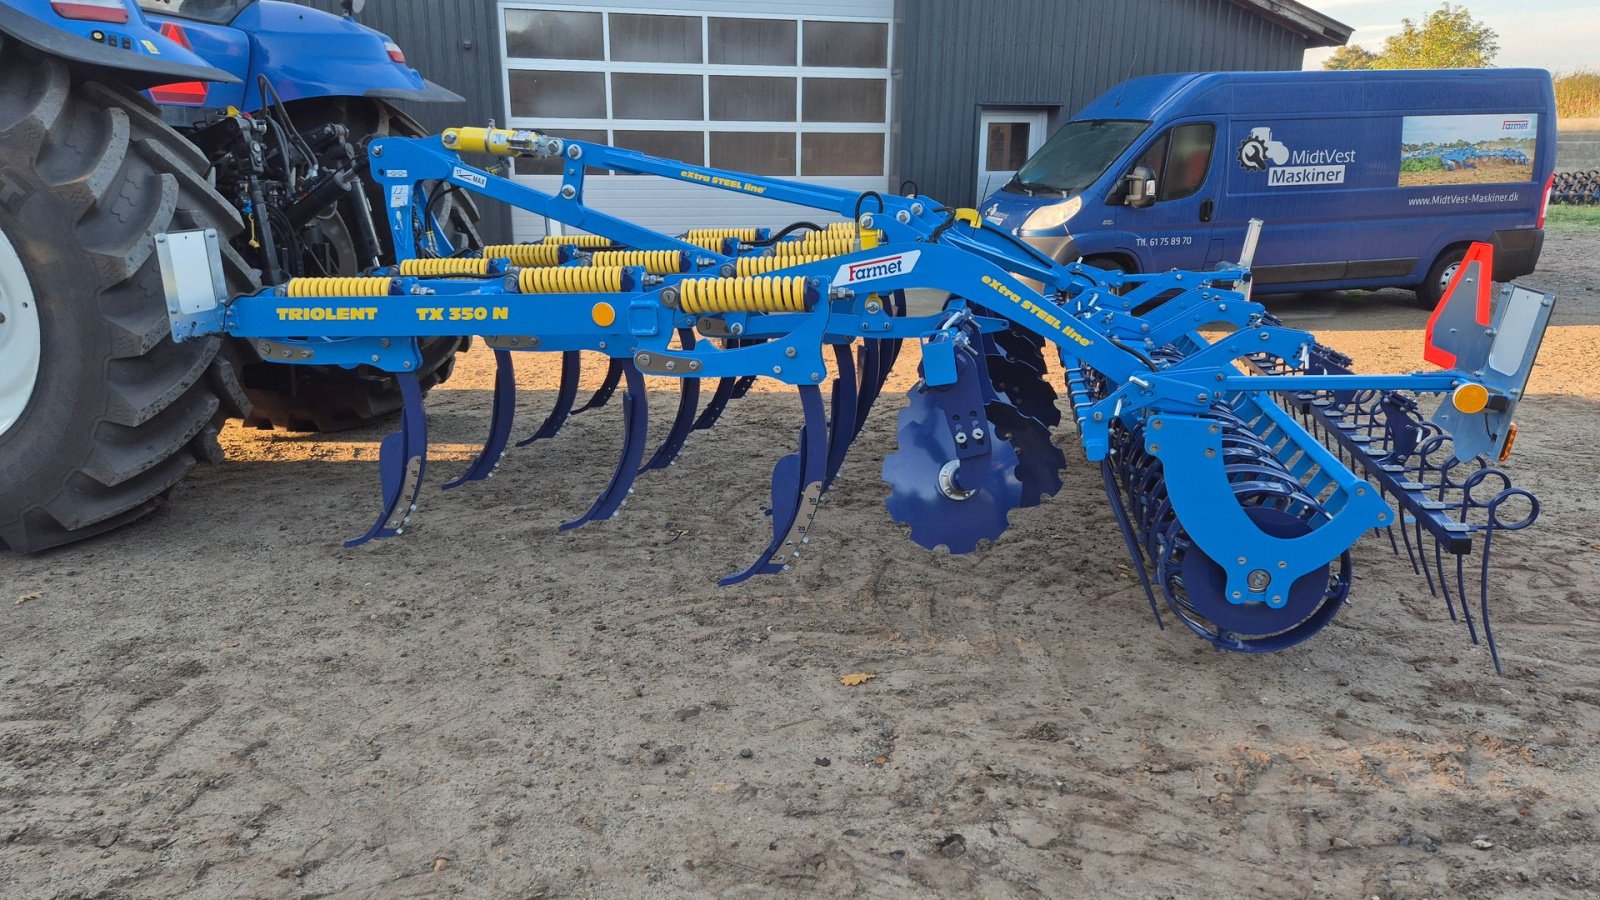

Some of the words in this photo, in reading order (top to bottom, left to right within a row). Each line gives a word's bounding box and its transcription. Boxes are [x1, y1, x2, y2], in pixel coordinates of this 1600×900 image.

[1502, 120, 1529, 131] Farmet
[1291, 149, 1356, 164] MidtVest
[472, 176, 486, 186] MAX
[681, 170, 710, 183] eXtra
[711, 176, 742, 189] STEEL
[1271, 168, 1342, 184] Maskiner
[1408, 192, 1519, 206] www.MidtVest-Maskiner.dk
[1150, 238, 1158, 247] 61
[1160, 237, 1169, 246] 75
[1171, 236, 1180, 246] 89
[1182, 236, 1192, 245] 70
[848, 255, 902, 282] Farmet
[981, 275, 1021, 303] eXtra
[1021, 300, 1061, 330] STEEL
[276, 307, 378, 321] TRIOLENT
[415, 307, 445, 321] TX
[448, 306, 488, 321] 350
[492, 306, 509, 320] N
